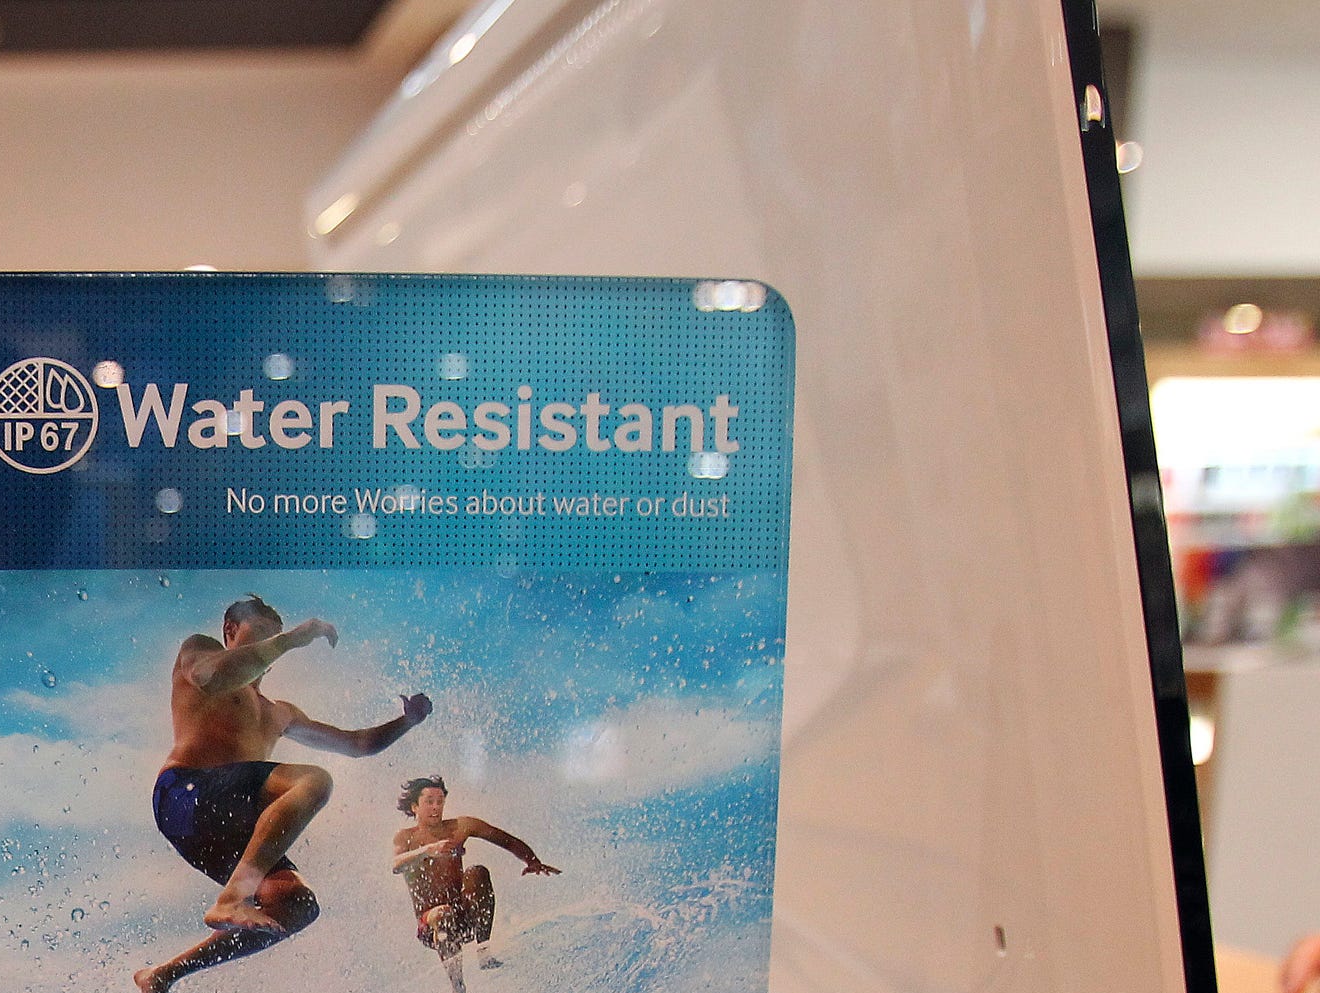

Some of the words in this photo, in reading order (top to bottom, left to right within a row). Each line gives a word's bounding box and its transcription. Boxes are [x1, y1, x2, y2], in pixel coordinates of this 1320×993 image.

[117, 382, 349, 449] Water
[373, 384, 740, 453] Resistant
[3, 422, 35, 451] IP
[40, 421, 79, 451] 67
[227, 488, 265, 514] No
[273, 494, 348, 514] more
[355, 488, 458, 515] Worries
[466, 491, 545, 516] about
[552, 495, 630, 517] water
[635, 499, 665, 517] or
[671, 491, 731, 518] dust
